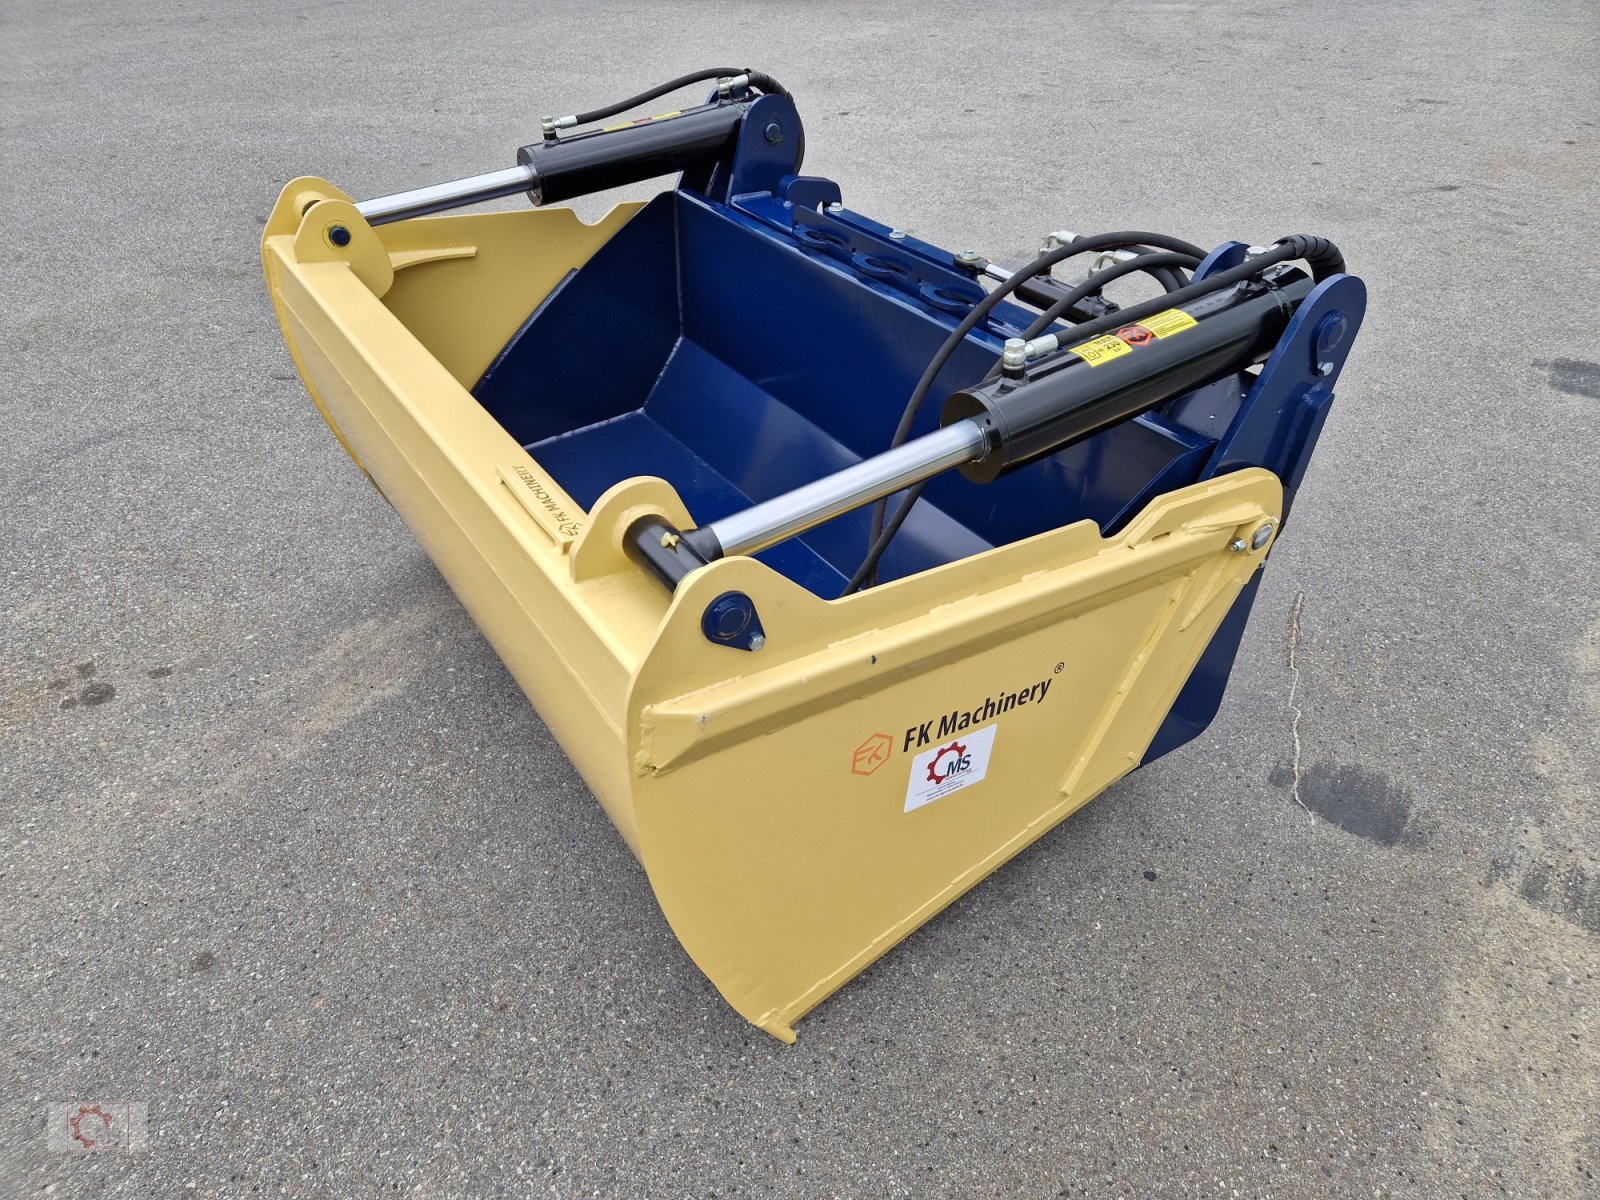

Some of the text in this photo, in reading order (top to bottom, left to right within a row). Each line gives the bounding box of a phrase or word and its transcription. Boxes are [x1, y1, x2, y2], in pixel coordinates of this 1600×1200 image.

[512, 465, 560, 512] MACHINERY
[551, 511, 571, 522] FK
[903, 720, 934, 753] FK
[936, 678, 1053, 740] Machinery
